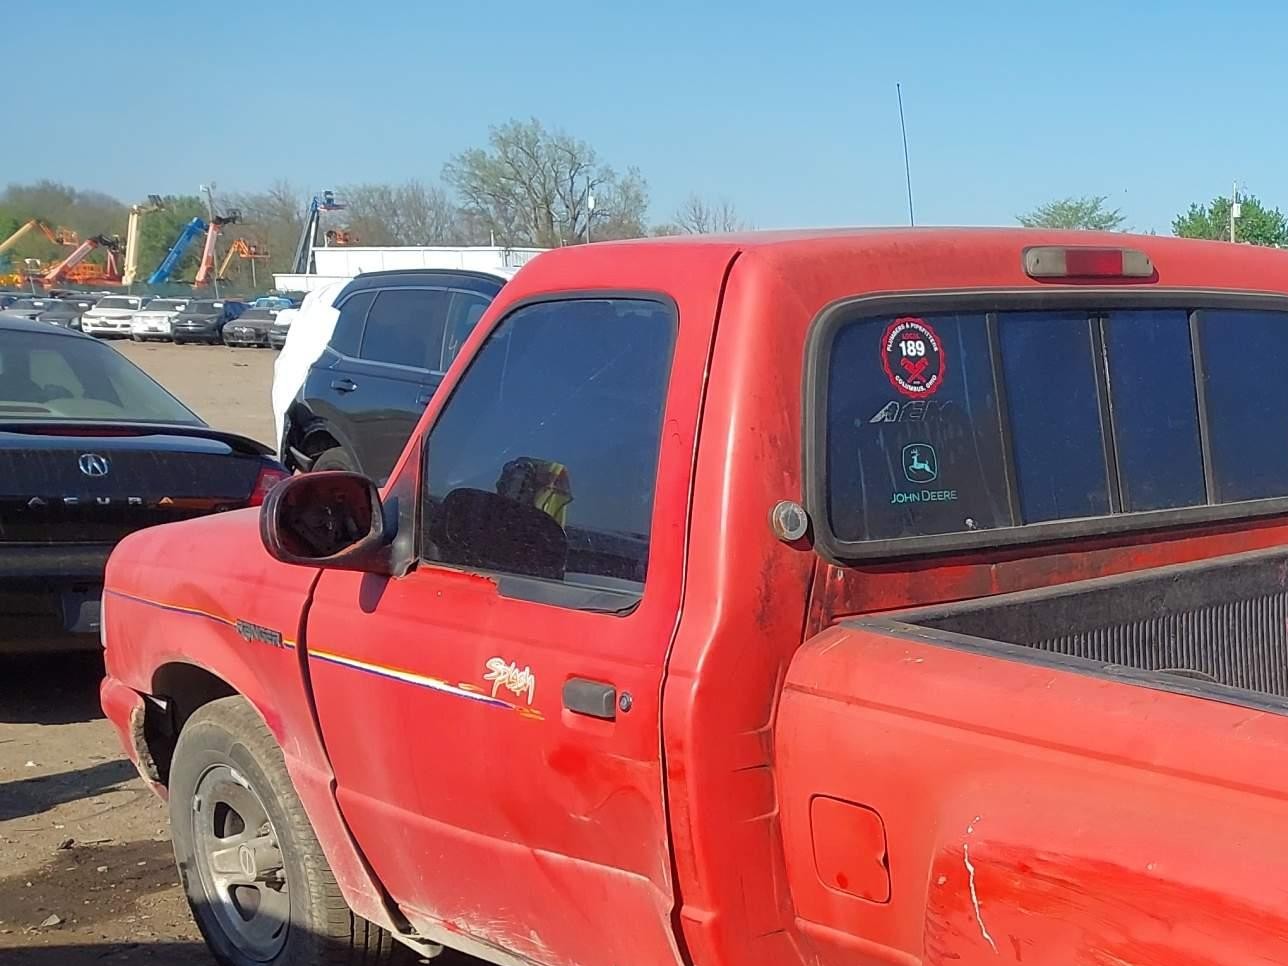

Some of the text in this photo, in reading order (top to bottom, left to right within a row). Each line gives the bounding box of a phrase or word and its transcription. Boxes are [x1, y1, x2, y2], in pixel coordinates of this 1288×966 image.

[899, 341, 925, 357] 189
[27, 496, 174, 505] ACURA
[891, 490, 958, 504] JOHN DEERE
